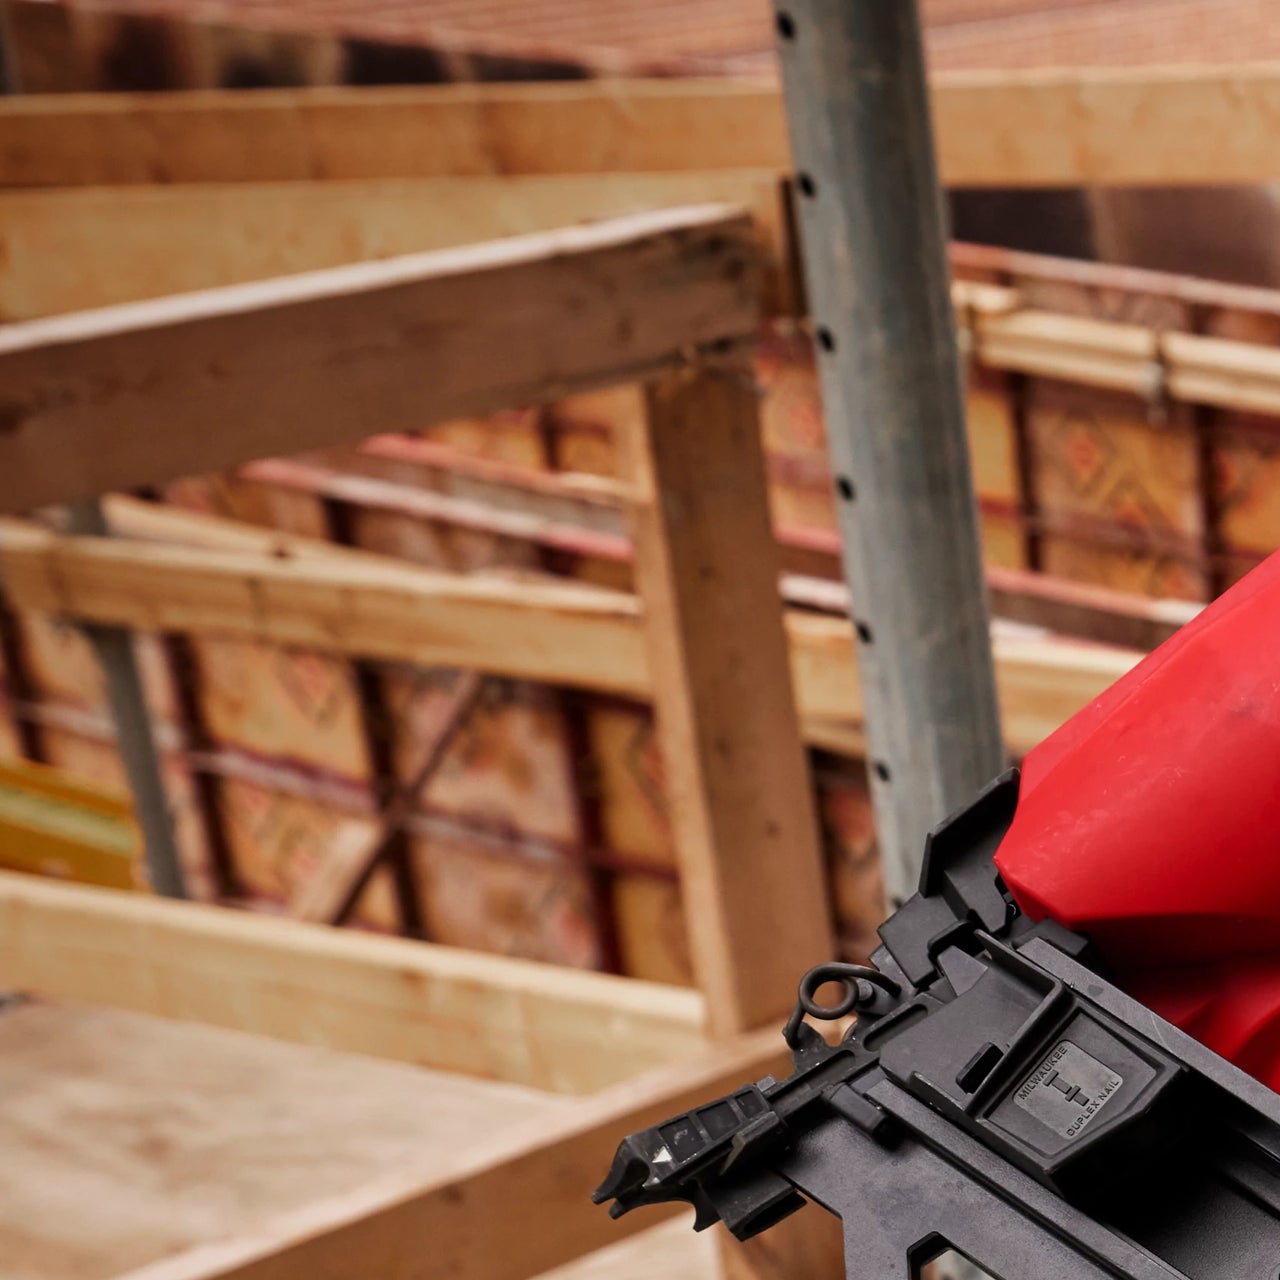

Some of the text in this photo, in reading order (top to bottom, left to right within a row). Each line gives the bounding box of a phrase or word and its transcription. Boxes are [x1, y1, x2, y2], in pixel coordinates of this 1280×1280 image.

[1018, 1046, 1068, 1100] MILWAUKEE
[1066, 1081, 1119, 1137] DUPLEX NAIL
